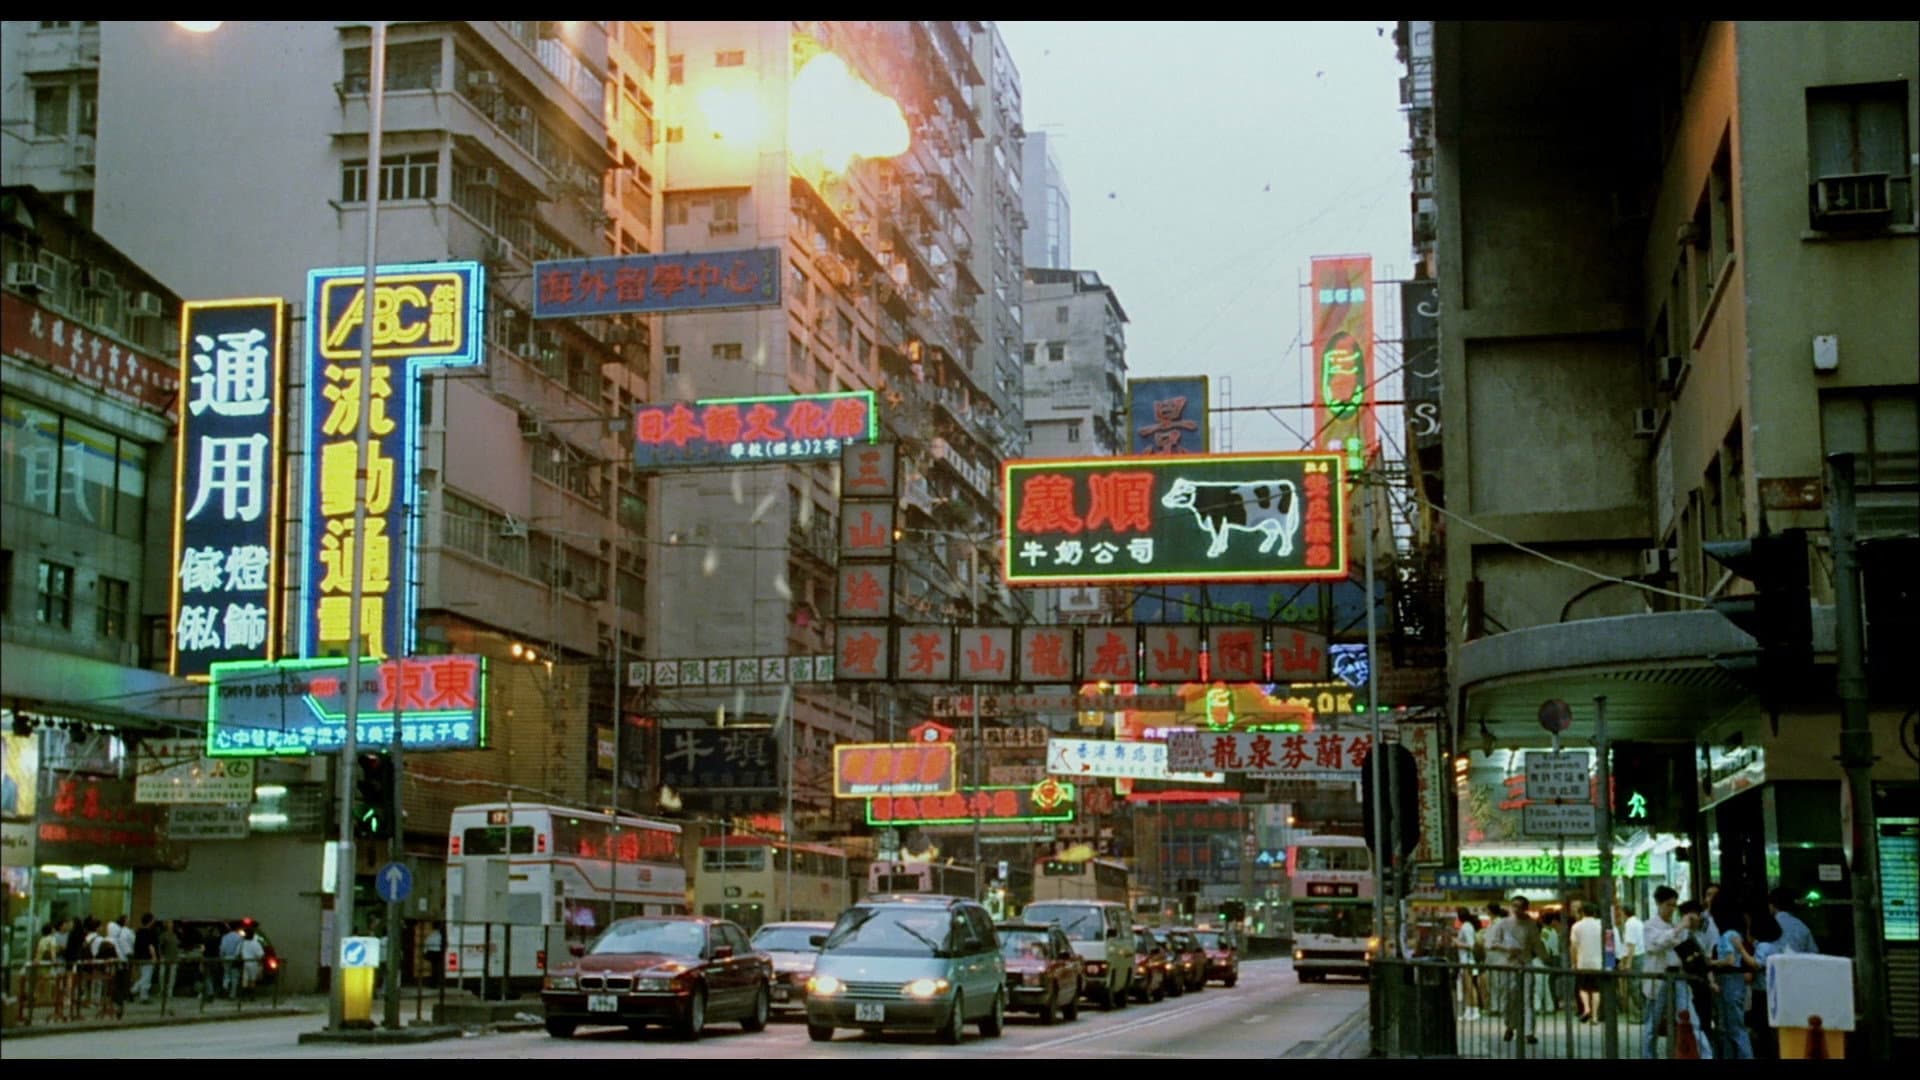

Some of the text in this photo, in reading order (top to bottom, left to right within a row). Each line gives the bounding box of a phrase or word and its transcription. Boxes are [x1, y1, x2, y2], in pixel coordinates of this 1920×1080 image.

[540, 258, 758, 305] 海外留學中心
[327, 285, 427, 346] ABC
[186, 328, 270, 521] 通用
[638, 400, 867, 446] 日本語文化館
[318, 364, 394, 657] 流動通訊
[1017, 471, 1154, 534] 義順
[1020, 536, 1154, 567] 牛奶公司
